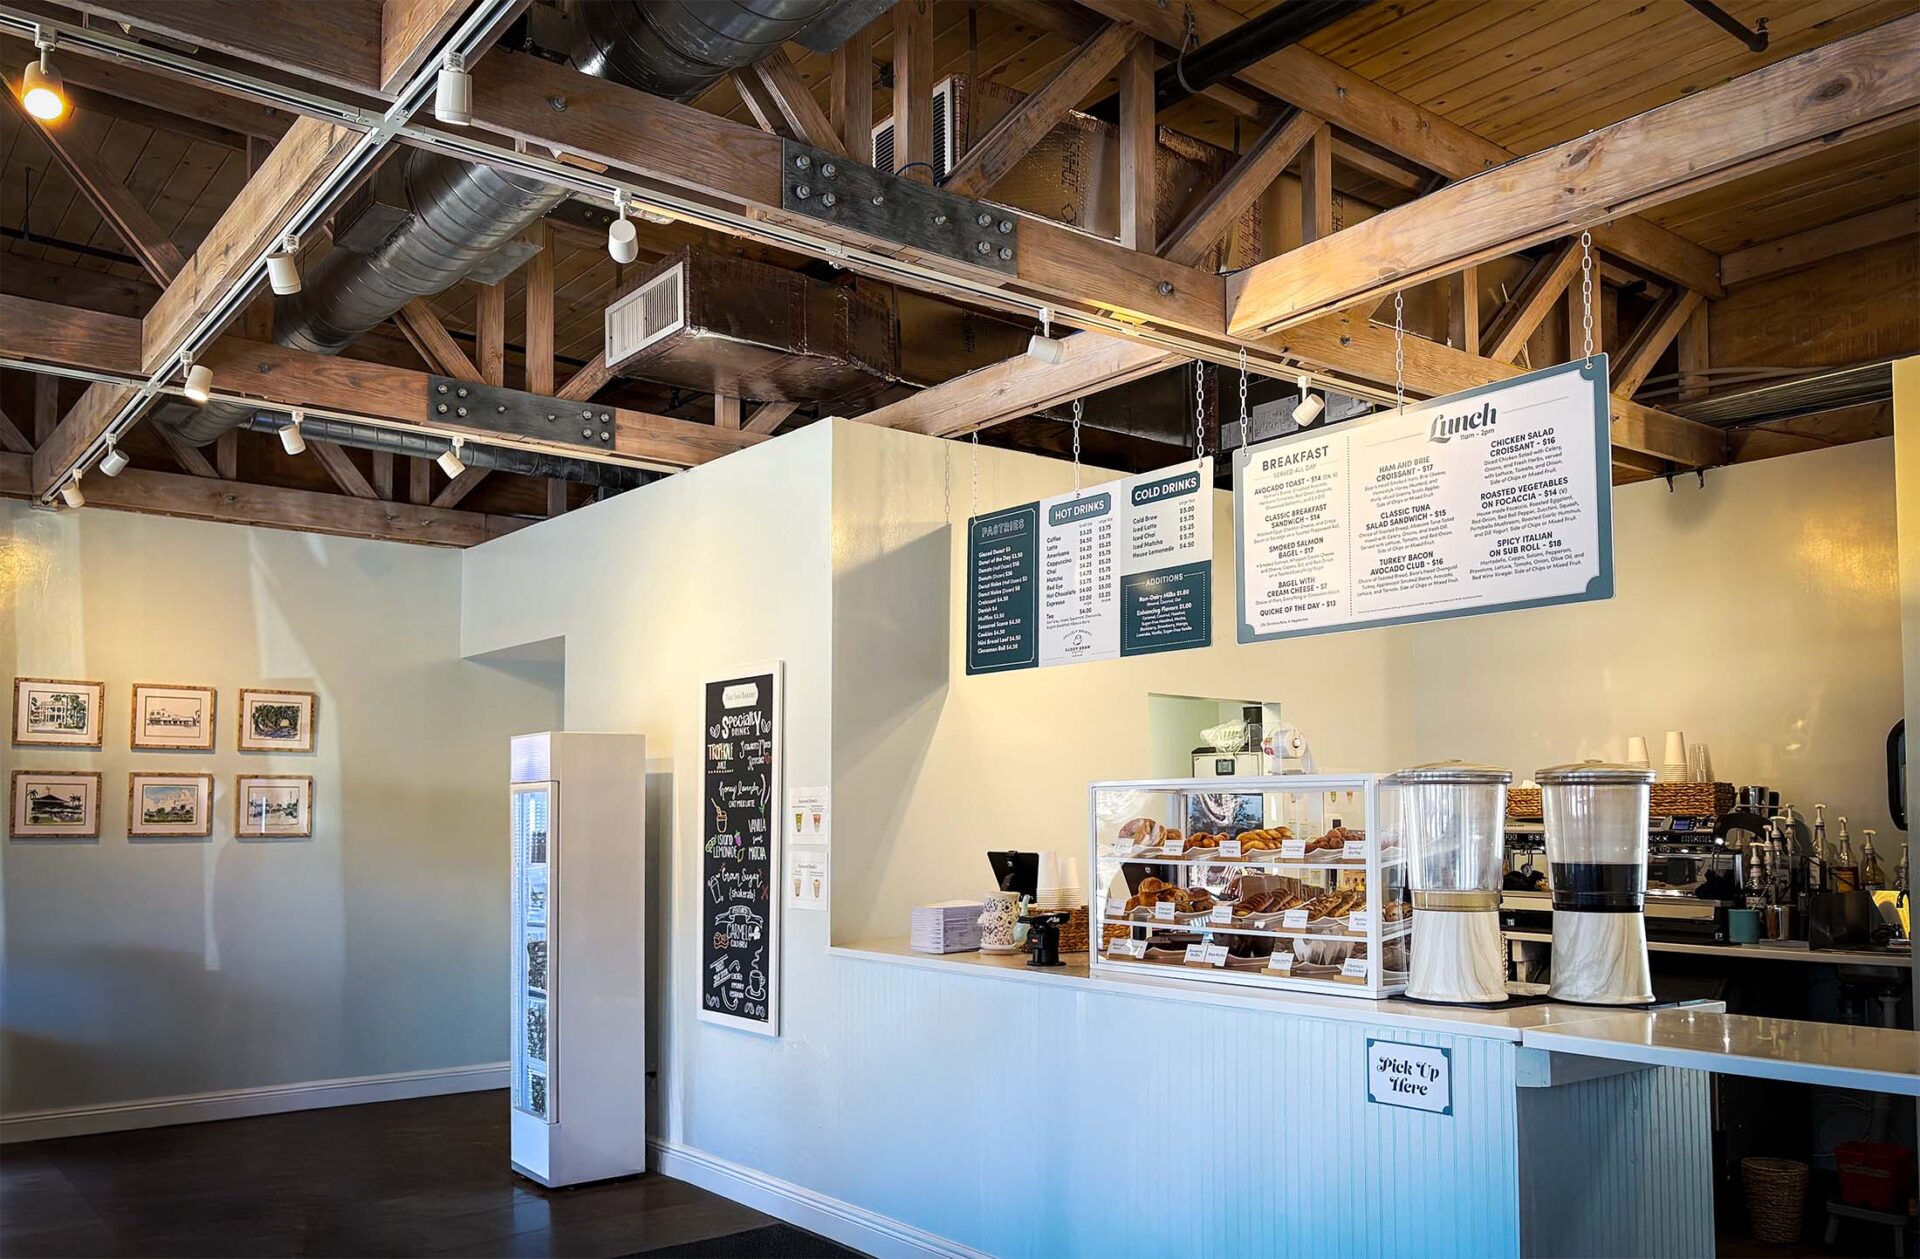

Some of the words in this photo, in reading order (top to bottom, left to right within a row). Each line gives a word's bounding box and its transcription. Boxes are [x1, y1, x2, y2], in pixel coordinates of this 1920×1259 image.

[1429, 401, 1497, 447] Lunch
[1481, 428, 1495, 437] 2pm
[1491, 434, 1526, 448] CHICKEN
[1528, 428, 1554, 440] SALAD
[1490, 441, 1535, 458] CROISSANT
[1543, 437, 1556, 446] $16
[1263, 446, 1329, 472] BREAKFAST
[1379, 464, 1396, 473] HAM
[1397, 460, 1412, 469] AND
[1414, 456, 1430, 466] BRIE
[1274, 468, 1294, 479] SERVED
[1295, 466, 1304, 474] ALL
[1306, 463, 1316, 471] DAY
[1376, 468, 1416, 483] CROISSANT
[1423, 464, 1434, 473] $17
[1135, 486, 1160, 501] COLD
[1163, 477, 1197, 495] DRINKS
[1255, 483, 1284, 495] AVOCADO
[1286, 478, 1305, 488] TOAST
[1311, 475, 1321, 483] $14
[1481, 487, 1516, 501] ROASTED
[1518, 477, 1569, 493] VEGETABLES
[1482, 501, 1493, 510] ON
[1496, 493, 1537, 507] FOCACCIA
[1544, 489, 1557, 498] $14
[1559, 487, 1568, 495] (V)
[1055, 508, 1072, 520] HOT
[1074, 500, 1105, 516] DRINKS
[1265, 512, 1290, 522] CLASSIC
[1292, 504, 1327, 517] BREAKFAST
[1380, 508, 1410, 520] CLASSIC
[1411, 504, 1431, 514] TUNA
[1133, 517, 1144, 525] Cold
[1145, 514, 1157, 522] Brew
[1144, 523, 1157, 531] Latte
[1271, 517, 1304, 529] SANDWICH
[1310, 513, 1320, 521] $14
[1366, 521, 1388, 531] SALAD
[1390, 513, 1428, 526] SANDWICH
[1435, 509, 1447, 518] $15
[982, 518, 1025, 538] PASTRIES
[1047, 536, 1061, 544] Coffee
[1144, 539, 1163, 548] Matcha
[1269, 542, 1296, 553] SMOKED
[1297, 537, 1324, 548] SALMON
[1497, 537, 1521, 547] SPICY
[1523, 532, 1553, 543] ITALIAN
[1047, 550, 1069, 559] Americano
[1133, 550, 1148, 558] House
[1149, 545, 1174, 555] Lemonade
[1180, 541, 1194, 550] $4.50
[1279, 550, 1298, 559] BAGEL
[1489, 549, 1501, 558] ON
[1503, 547, 1518, 556] SUB
[1520, 543, 1541, 553] ROLL
[1549, 540, 1562, 548] $18
[1047, 558, 1072, 568] Cappuccino
[1380, 556, 1407, 566] TURKEY
[1409, 551, 1434, 561] BACON
[1371, 565, 1405, 576] AVOCADO
[1406, 562, 1425, 570] CLUB
[1432, 558, 1443, 566] $16
[1145, 574, 1184, 586] ADDITIONS
[1278, 580, 1298, 588] BAGEL
[1299, 577, 1315, 585] WITH
[1055, 589, 1076, 598] Chocolate
[1139, 594, 1162, 604] Non-Dairy
[1267, 589, 1289, 598] CREAM
[1291, 585, 1314, 594] CHEESE
[1137, 607, 1161, 617] Enhancing
[1260, 608, 1283, 617] QUICHE
[1326, 600, 1336, 608] $13
[732, 727, 750, 736] DRINKS
[748, 818, 766, 832] VANILLA
[713, 846, 737, 858] LEMONADE
[748, 846, 767, 860] MATCHA
[1377, 1056, 1412, 1075] Pick
[1416, 1062, 1439, 1082] Up
[1389, 1076, 1428, 1096] Here
